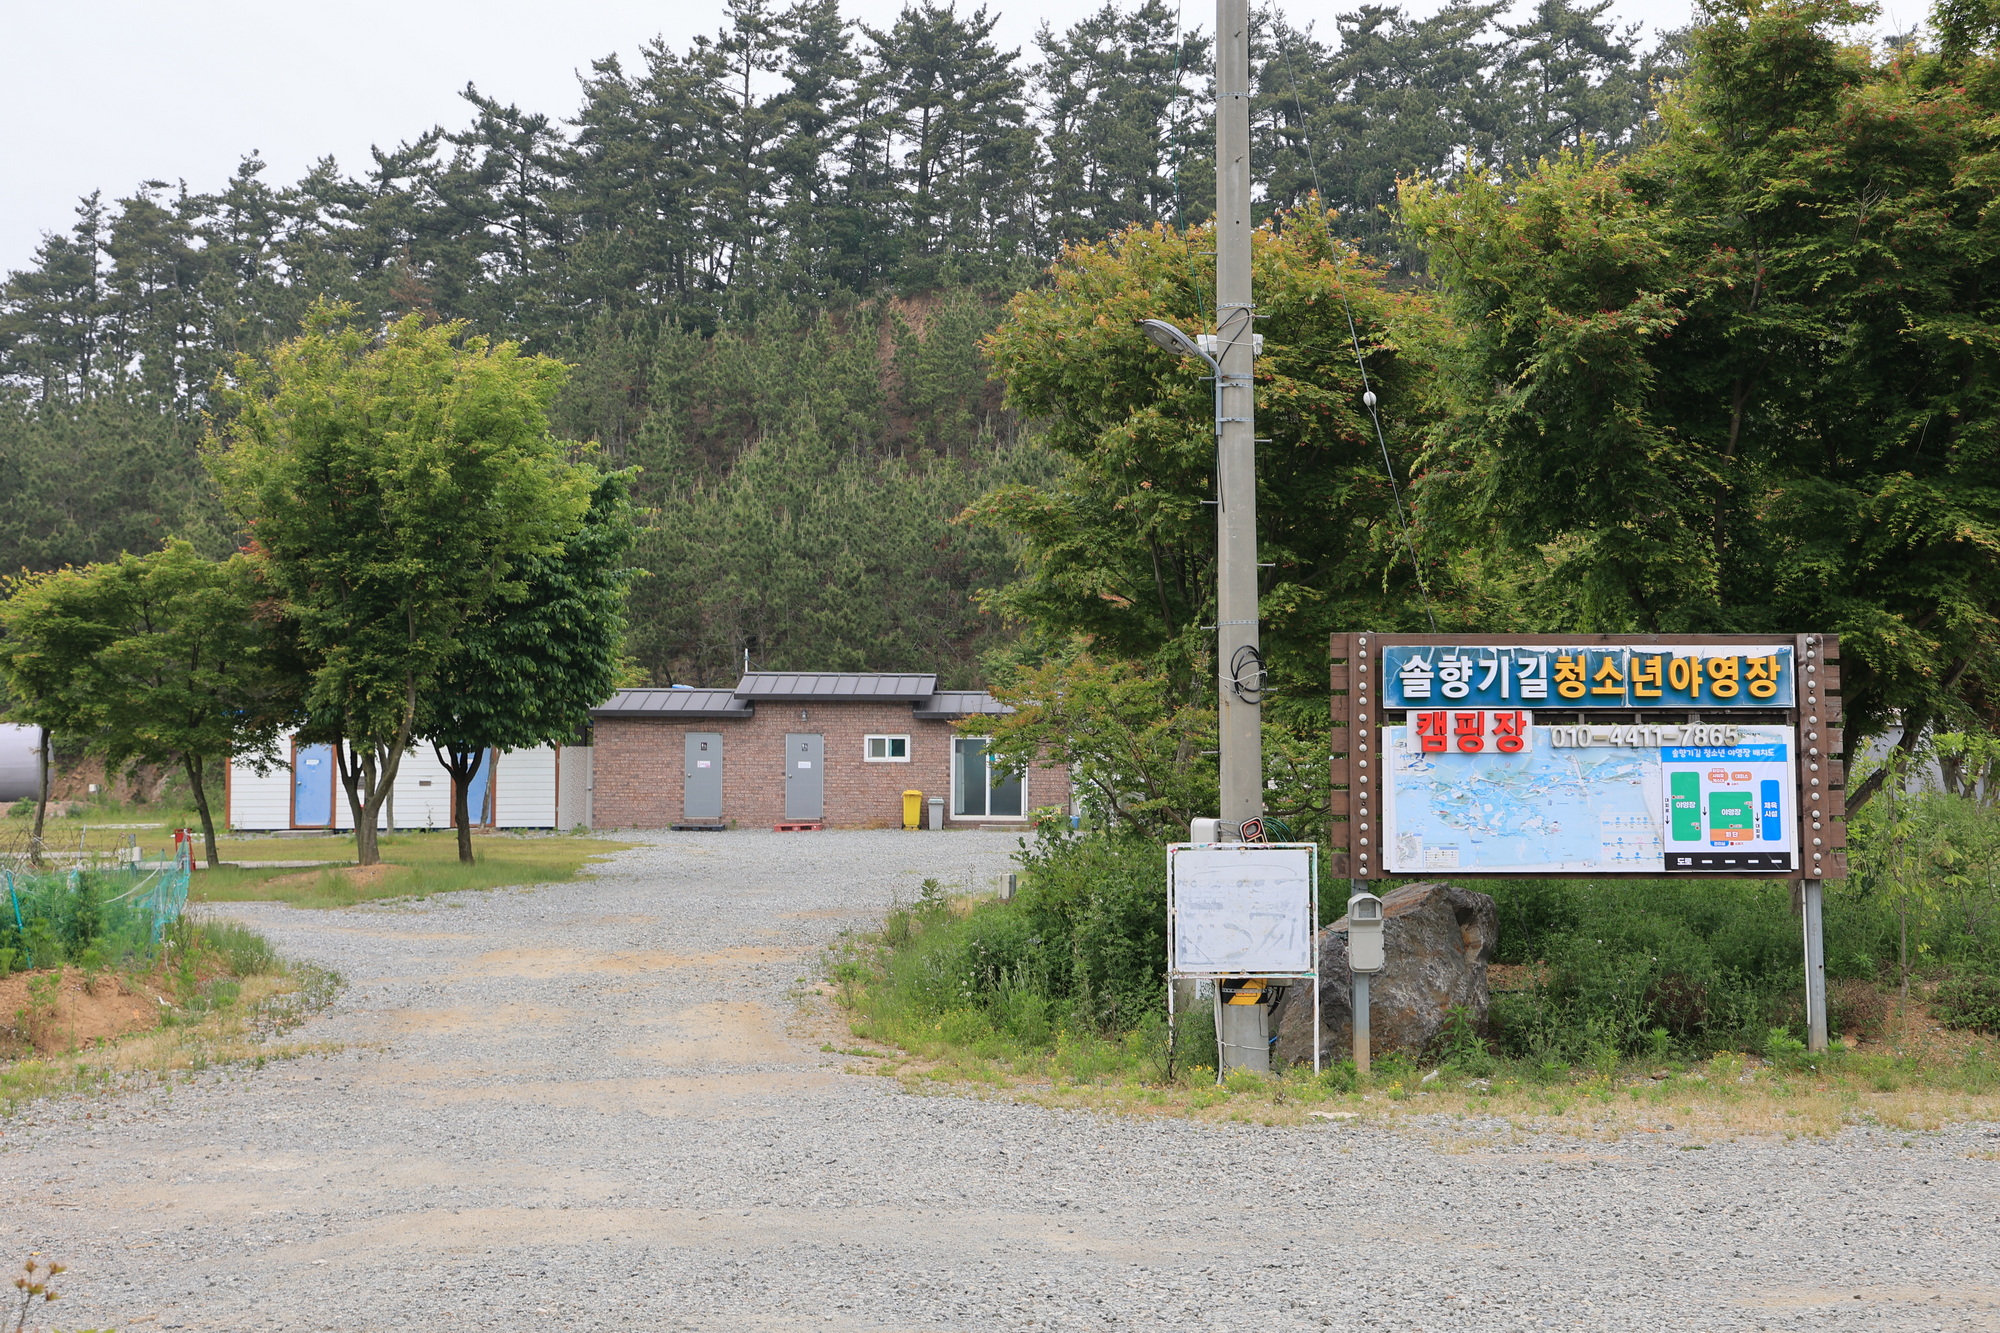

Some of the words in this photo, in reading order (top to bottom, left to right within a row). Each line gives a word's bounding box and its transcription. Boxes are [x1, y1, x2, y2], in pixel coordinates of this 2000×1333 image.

[1416, 711, 1527, 753] 캠핑장
[1551, 725, 1739, 748] 010-4411-7865
[1671, 748, 1702, 758] 솔향기길
[1703, 748, 1726, 758] 청소년
[1727, 748, 1751, 758] 야영장
[1752, 748, 1775, 757] 배치도
[1675, 801, 1696, 809] 야영장
[1763, 801, 1778, 809] 체육
[1721, 808, 1742, 816] 야영장
[1764, 810, 1778, 818] 시설
[1677, 857, 1693, 866] 도로
